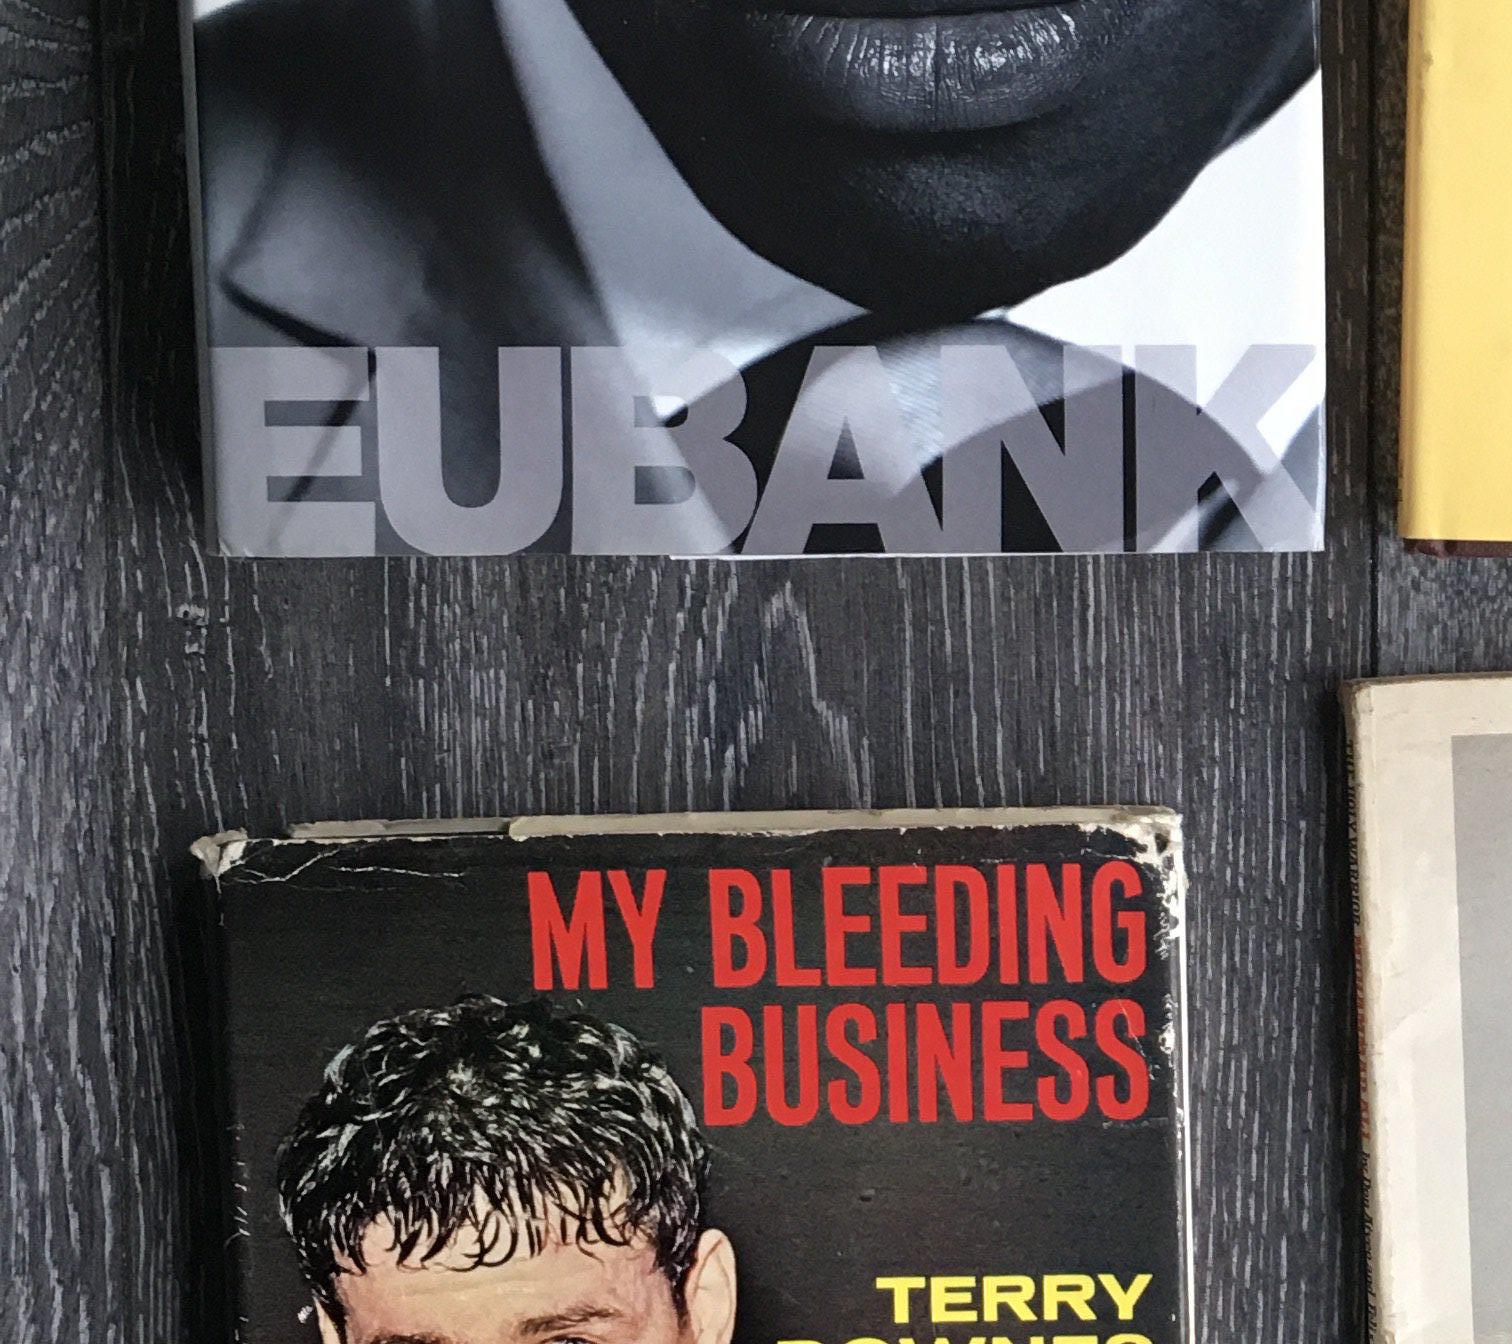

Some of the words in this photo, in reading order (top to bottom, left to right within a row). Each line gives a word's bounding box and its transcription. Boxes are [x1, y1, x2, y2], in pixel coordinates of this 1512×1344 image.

[212, 344, 1317, 556] EUBANK
[528, 869, 666, 990] MY
[708, 861, 1147, 989] BLEEDING
[701, 999, 1149, 1127] BUSINESS
[876, 1273, 1153, 1323] TERRY
